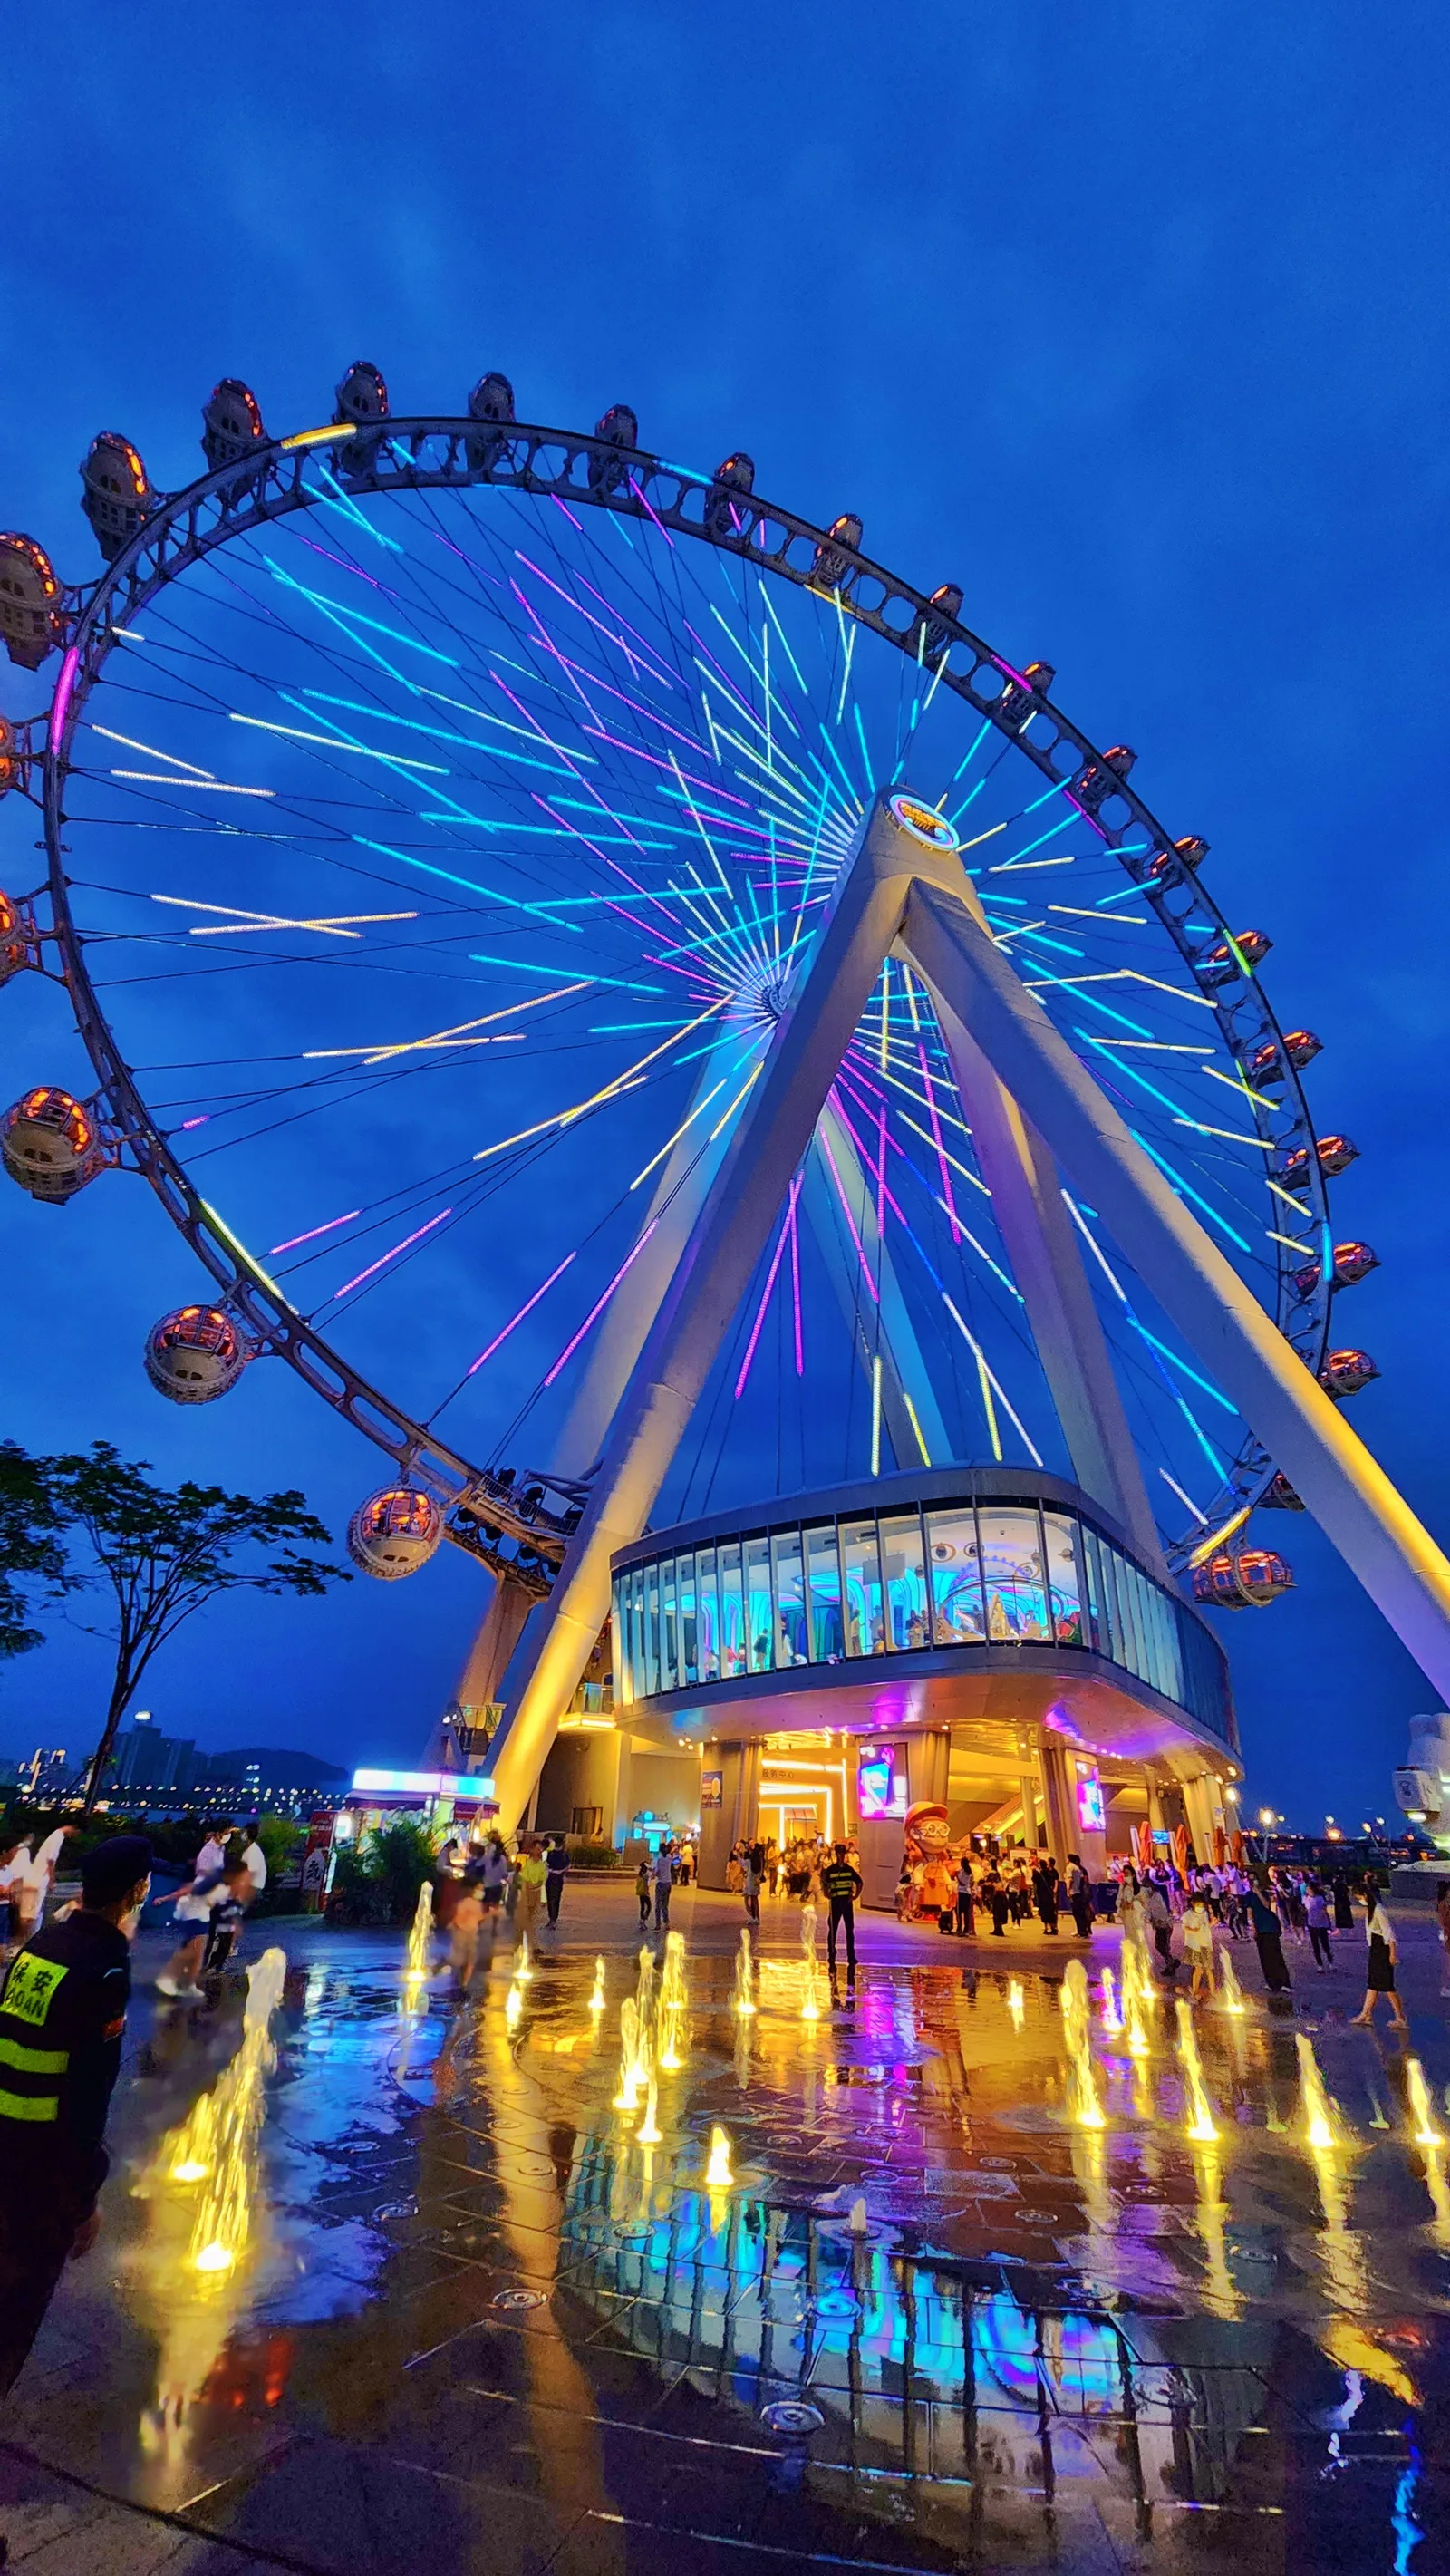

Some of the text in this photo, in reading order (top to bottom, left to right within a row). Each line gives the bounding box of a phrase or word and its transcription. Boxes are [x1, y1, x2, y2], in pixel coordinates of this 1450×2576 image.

[762, 1768, 795, 1779] 服务中心
[12, 1961, 54, 1996] 保安
[4, 1987, 45, 2019] AOAN
